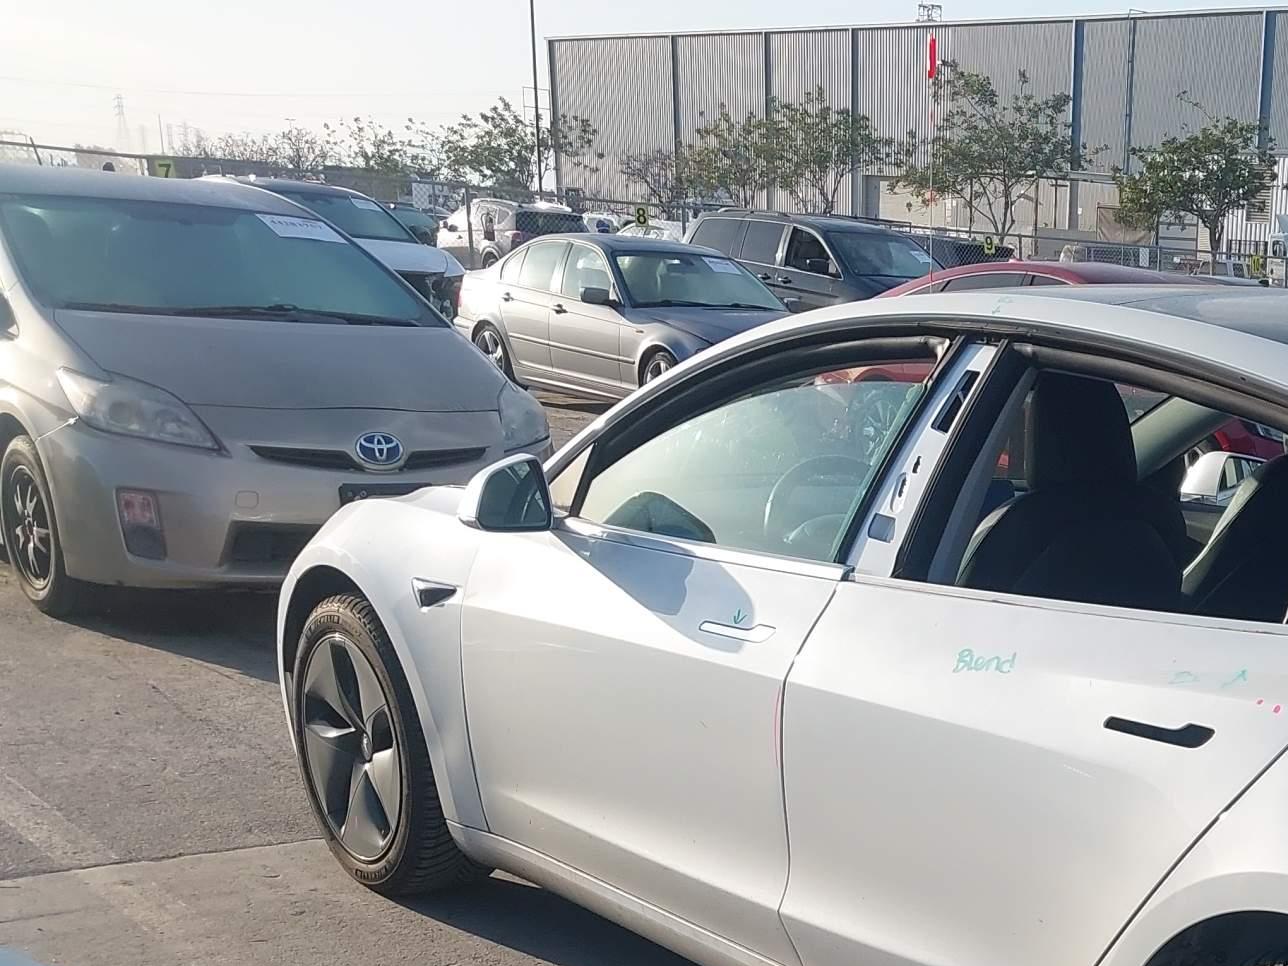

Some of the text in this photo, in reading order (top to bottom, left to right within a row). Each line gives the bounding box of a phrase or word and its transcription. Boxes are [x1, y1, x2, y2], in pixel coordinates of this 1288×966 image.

[158, 164, 171, 178] 7
[636, 207, 646, 225] 8
[985, 236, 993, 250] 9
[953, 649, 1017, 674] Blend
